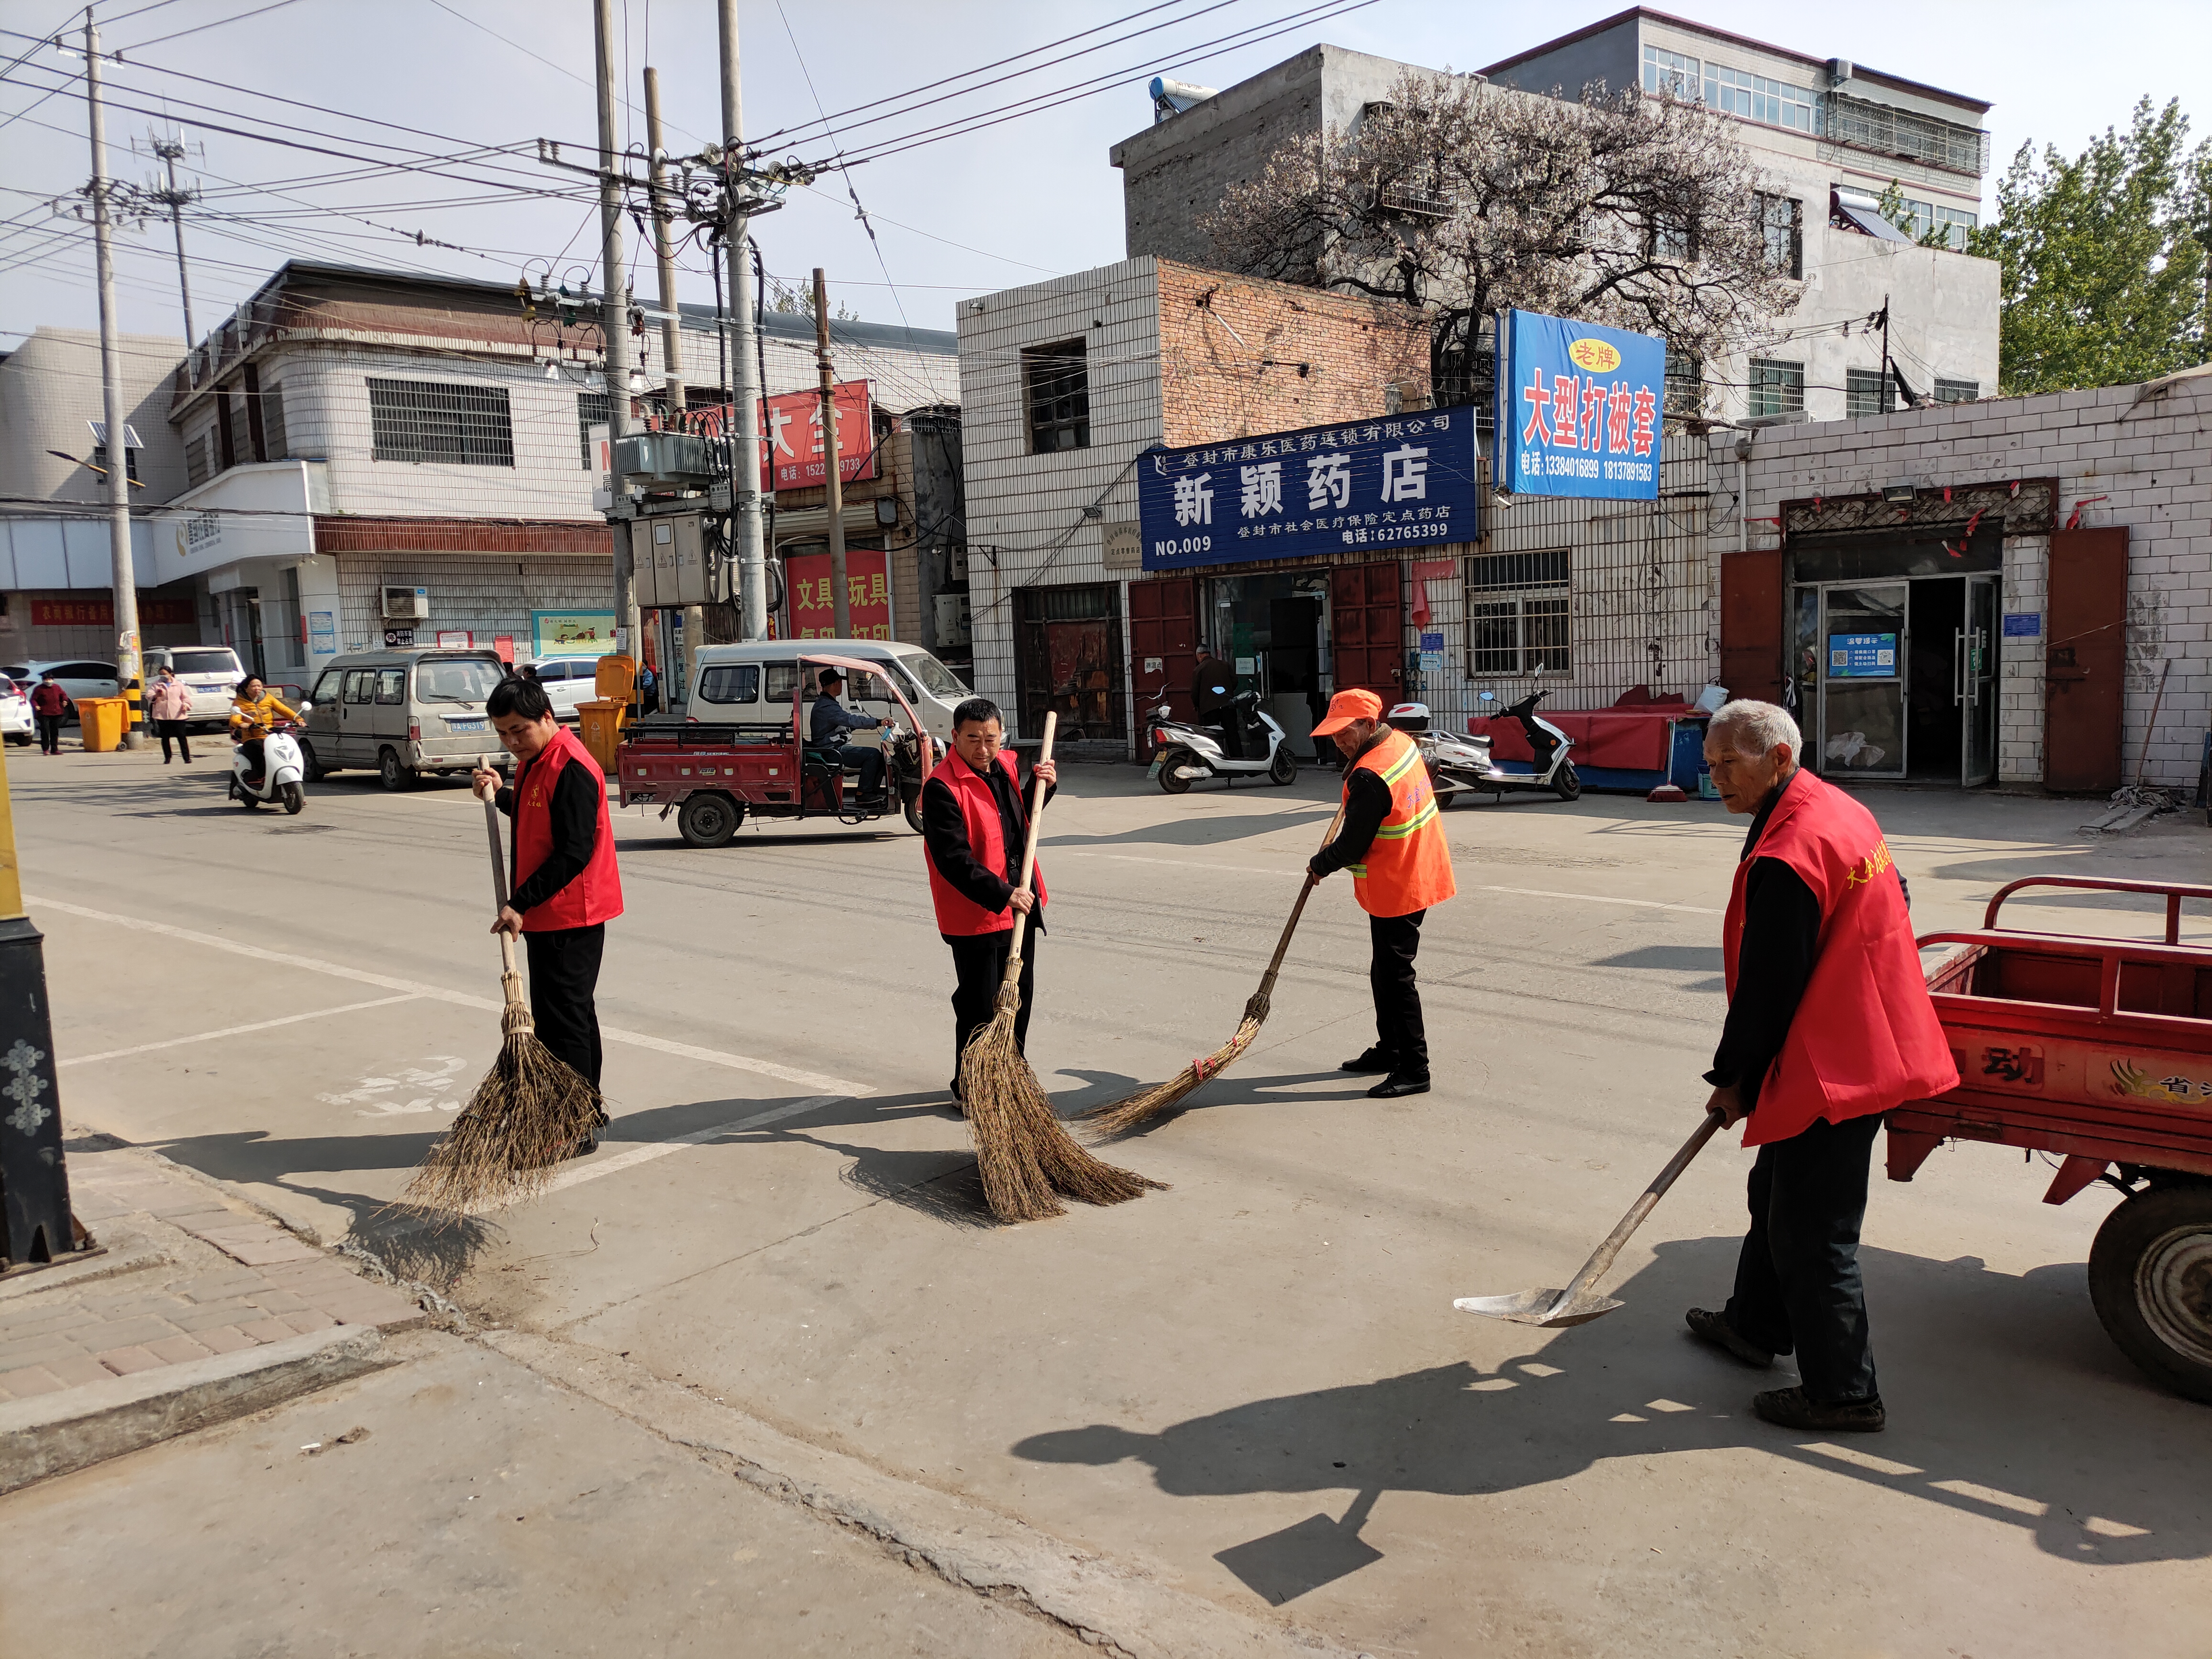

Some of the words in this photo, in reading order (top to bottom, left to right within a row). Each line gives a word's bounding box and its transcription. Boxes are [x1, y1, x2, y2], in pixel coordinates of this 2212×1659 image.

[1575, 342, 1615, 369] 老牌
[1523, 367, 1656, 458] 大型打被套
[1182, 414, 1451, 467] 登封市康乐医药连锁有限公司
[1174, 443, 1429, 526] 新颖药店
[1604, 461, 1652, 482] 18137891583
[1238, 506, 1451, 539] 登封市社会医疗保险定点药店
[1155, 535, 1211, 556] NO.009
[796, 577, 834, 610] 文具
[848, 573, 888, 608] 玩具
